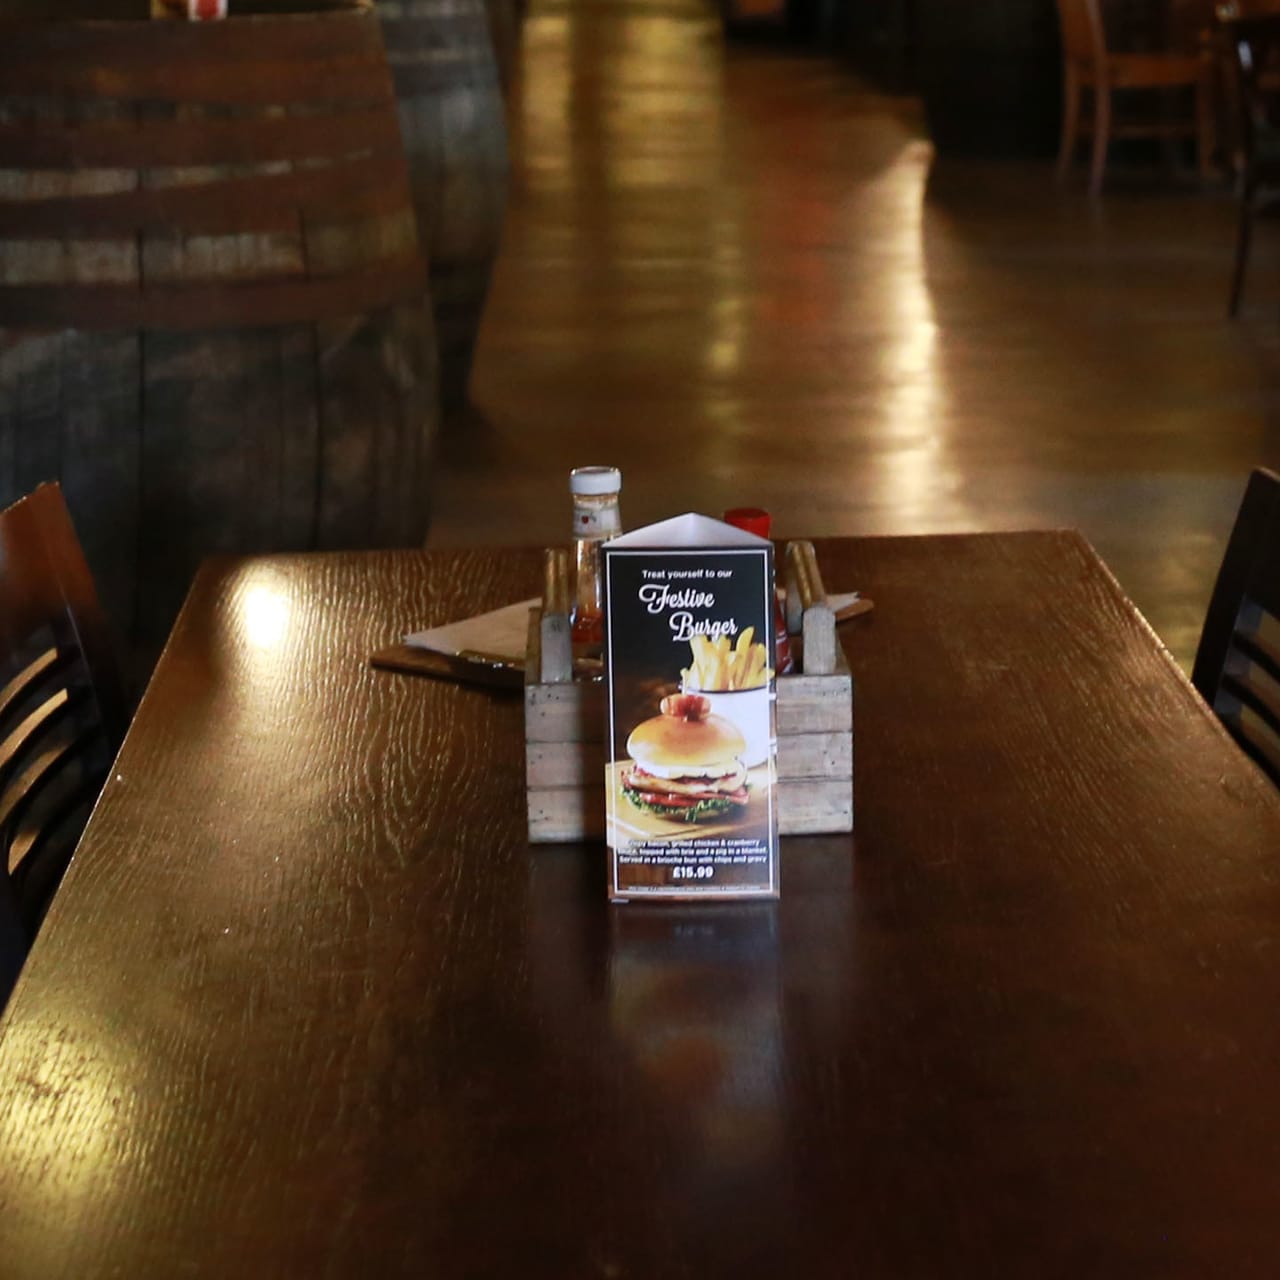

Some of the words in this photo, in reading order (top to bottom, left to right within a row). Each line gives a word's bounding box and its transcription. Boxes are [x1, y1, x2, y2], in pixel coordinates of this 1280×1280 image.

[642, 569, 665, 579] Treat
[667, 568, 703, 580] yourself
[705, 569, 715, 578] to
[717, 570, 733, 578] our
[638, 583, 715, 614] Festive
[669, 611, 739, 642] Burger
